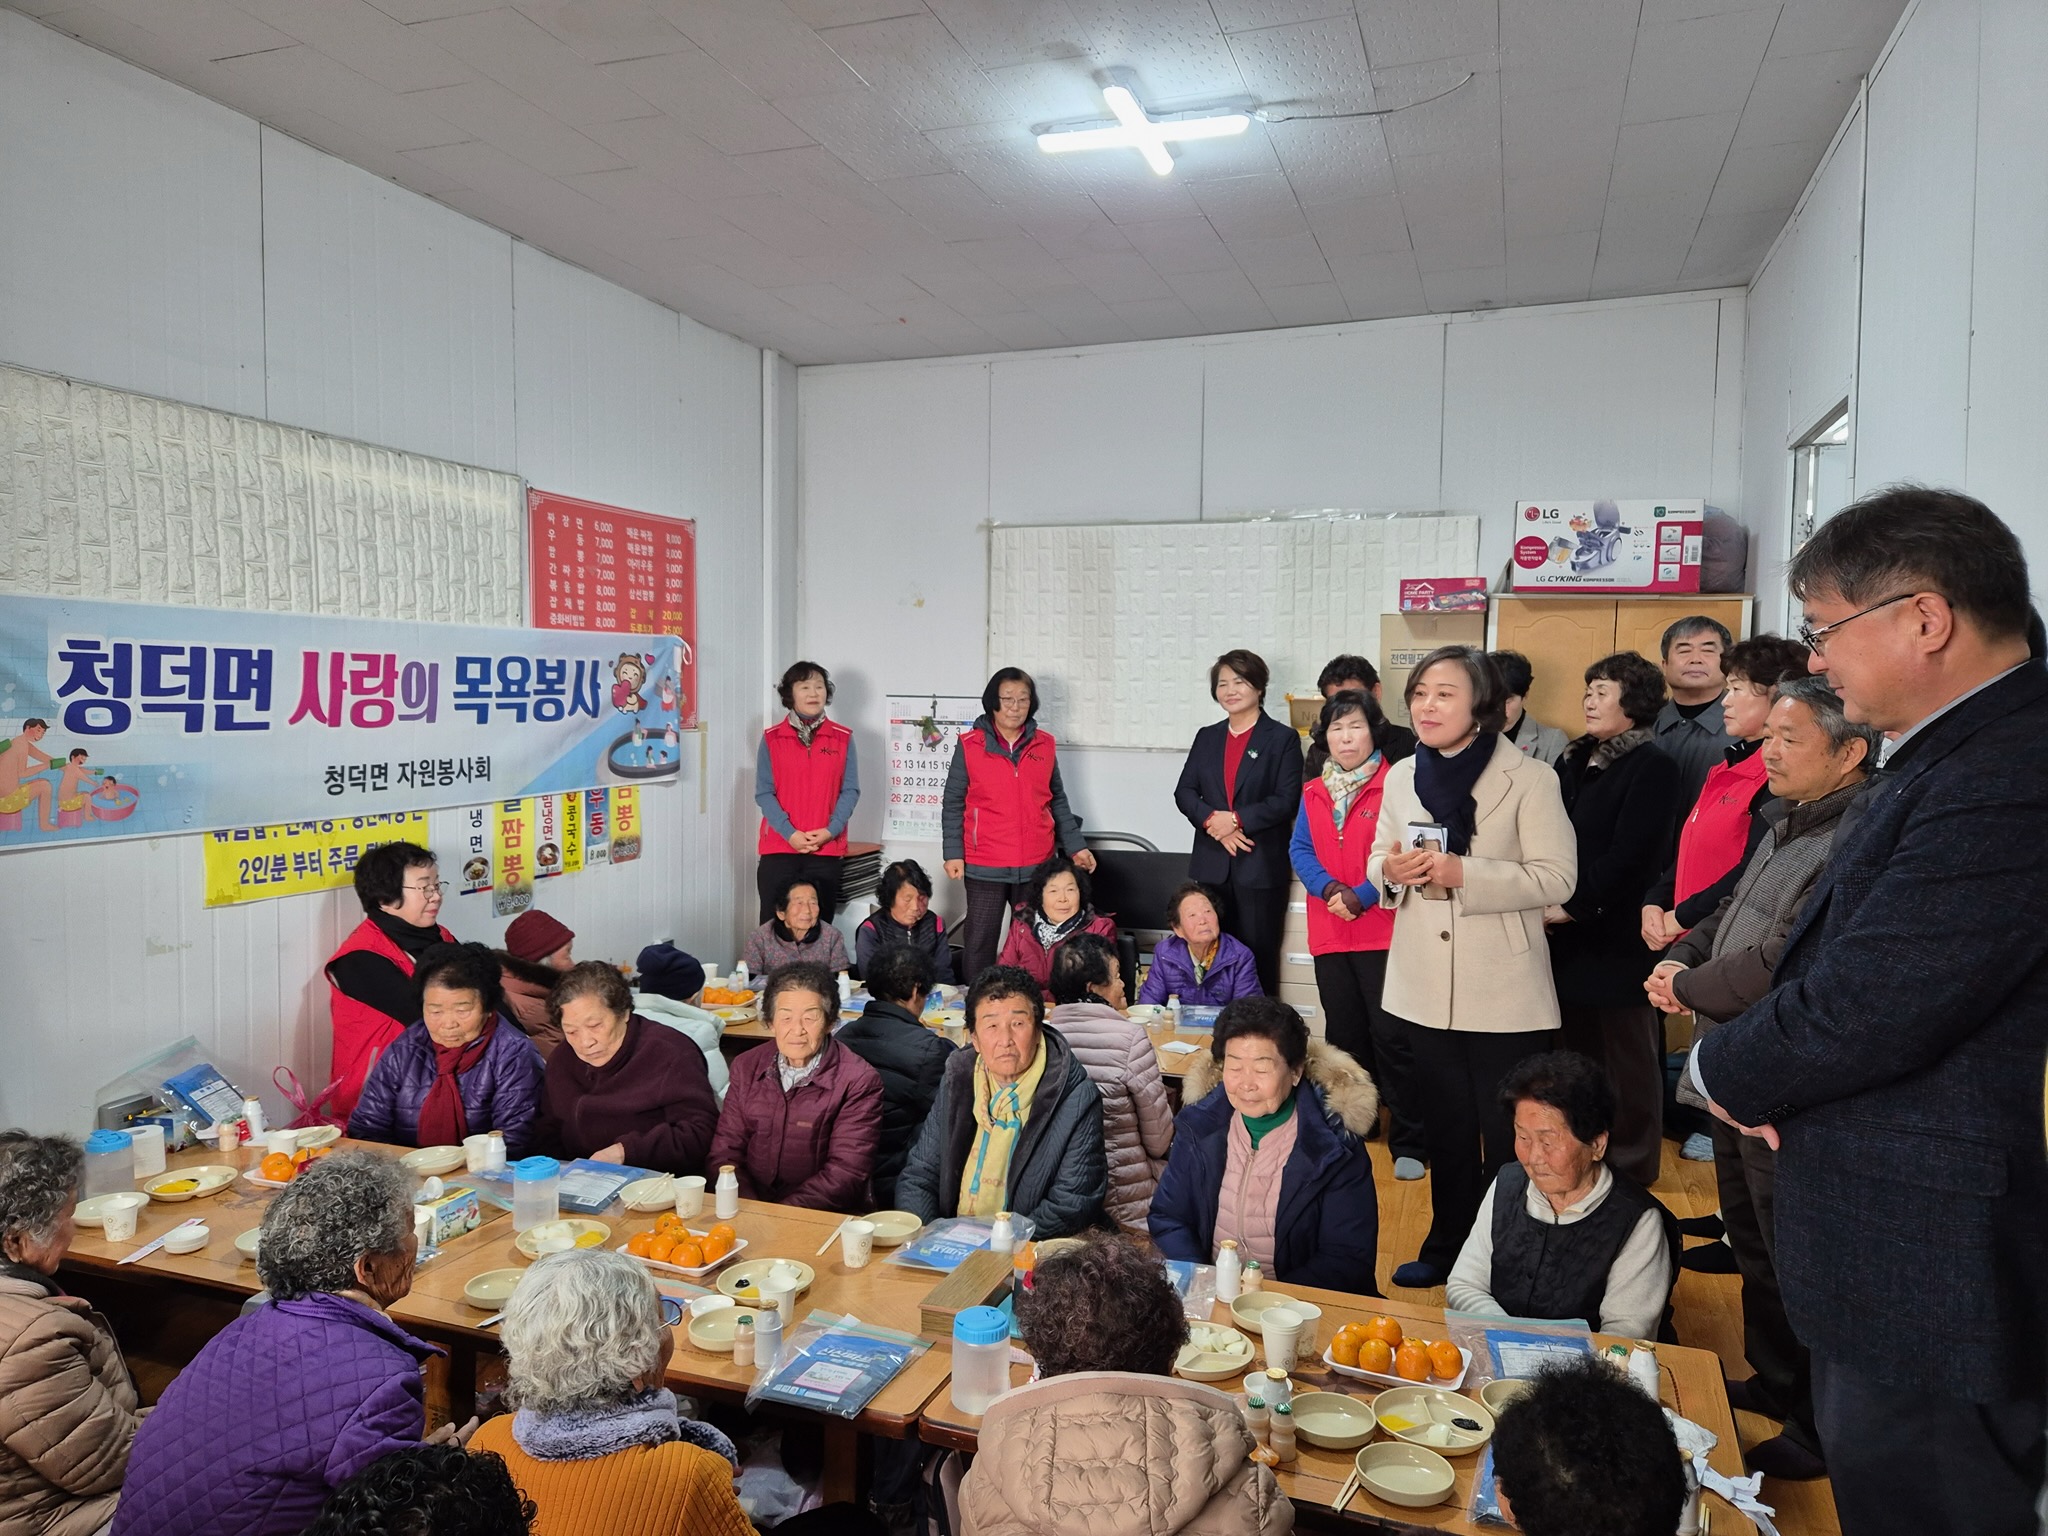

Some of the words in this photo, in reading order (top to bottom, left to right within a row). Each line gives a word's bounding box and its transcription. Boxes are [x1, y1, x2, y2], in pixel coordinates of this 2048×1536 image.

[1542, 508, 1559, 519] LG
[594, 521, 613, 533] 6,000
[594, 536, 614, 549] 7,000
[595, 552, 615, 565] 7,000
[596, 568, 615, 580] 7,000
[1535, 575, 1546, 583] LG
[1547, 575, 1583, 583] CYKING
[596, 585, 616, 597] 8,000
[596, 600, 616, 613] 8,000
[662, 610, 683, 621] 20,000
[595, 616, 616, 628] 8,000
[56, 638, 273, 736] 청덕면
[287, 650, 440, 729] 사랑의
[452, 655, 602, 725] 목욕봉사
[943, 726, 949, 736] 2
[894, 742, 900, 752] 5
[906, 742, 912, 752] 6
[918, 743, 924, 752] 7
[943, 743, 949, 753] 9
[892, 759, 902, 769] 12
[904, 759, 914, 769] 13
[916, 760, 926, 769] 14
[928, 760, 939, 770] 15
[941, 761, 951, 770] 16
[322, 761, 389, 796] 청덕면
[396, 755, 492, 789] 자원봉사회
[891, 776, 902, 785] 19
[903, 776, 914, 786] 20
[916, 777, 926, 786] 21
[928, 777, 939, 787] 22
[940, 778, 947, 788] 2
[891, 793, 902, 803] 26
[903, 793, 913, 803] 27
[915, 794, 926, 804] 28
[927, 794, 939, 804] 29
[589, 788, 605, 836] 우동
[566, 805, 577, 856] 콩국수
[238, 854, 288, 885] 2인분
[293, 848, 324, 880] 부터
[328, 844, 360, 874] 주문
